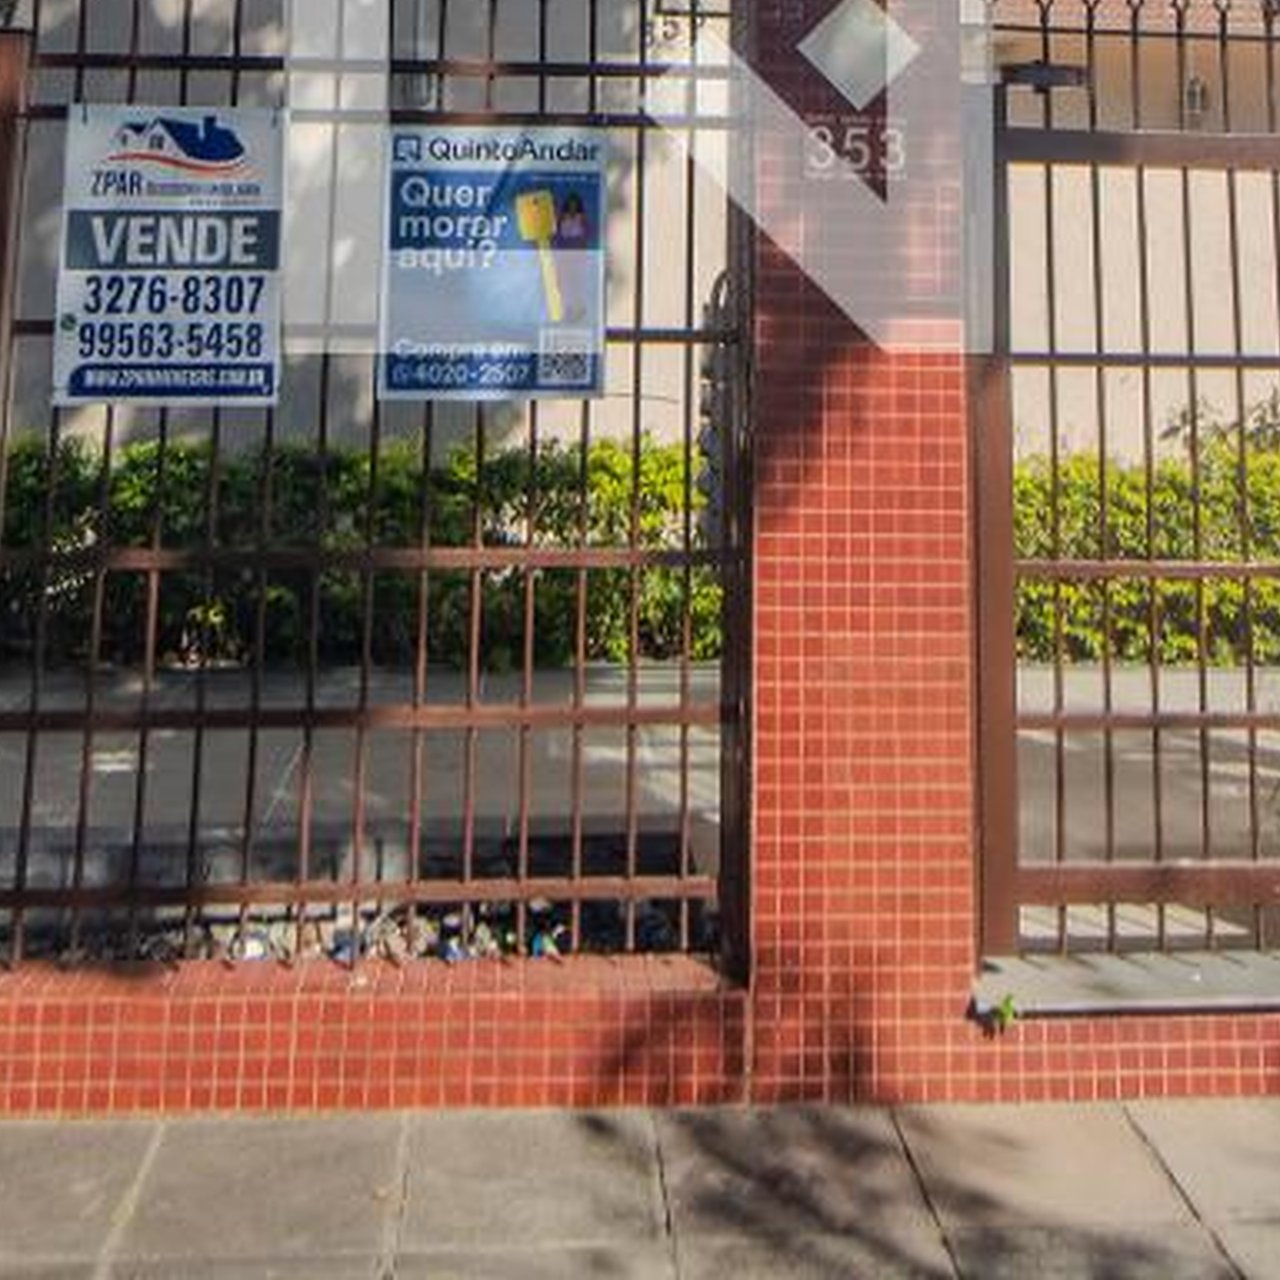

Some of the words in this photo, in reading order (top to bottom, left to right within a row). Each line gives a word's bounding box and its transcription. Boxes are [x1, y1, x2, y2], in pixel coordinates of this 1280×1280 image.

[428, 138, 598, 161] QuintoAndar
[807, 125, 906, 170] 353
[400, 176, 493, 208] Quer
[91, 216, 259, 265] VENDE
[398, 214, 508, 238] morar
[397, 240, 498, 275] aqui?
[83, 275, 266, 315] 3276-8307
[78, 322, 263, 358] 99563-5458
